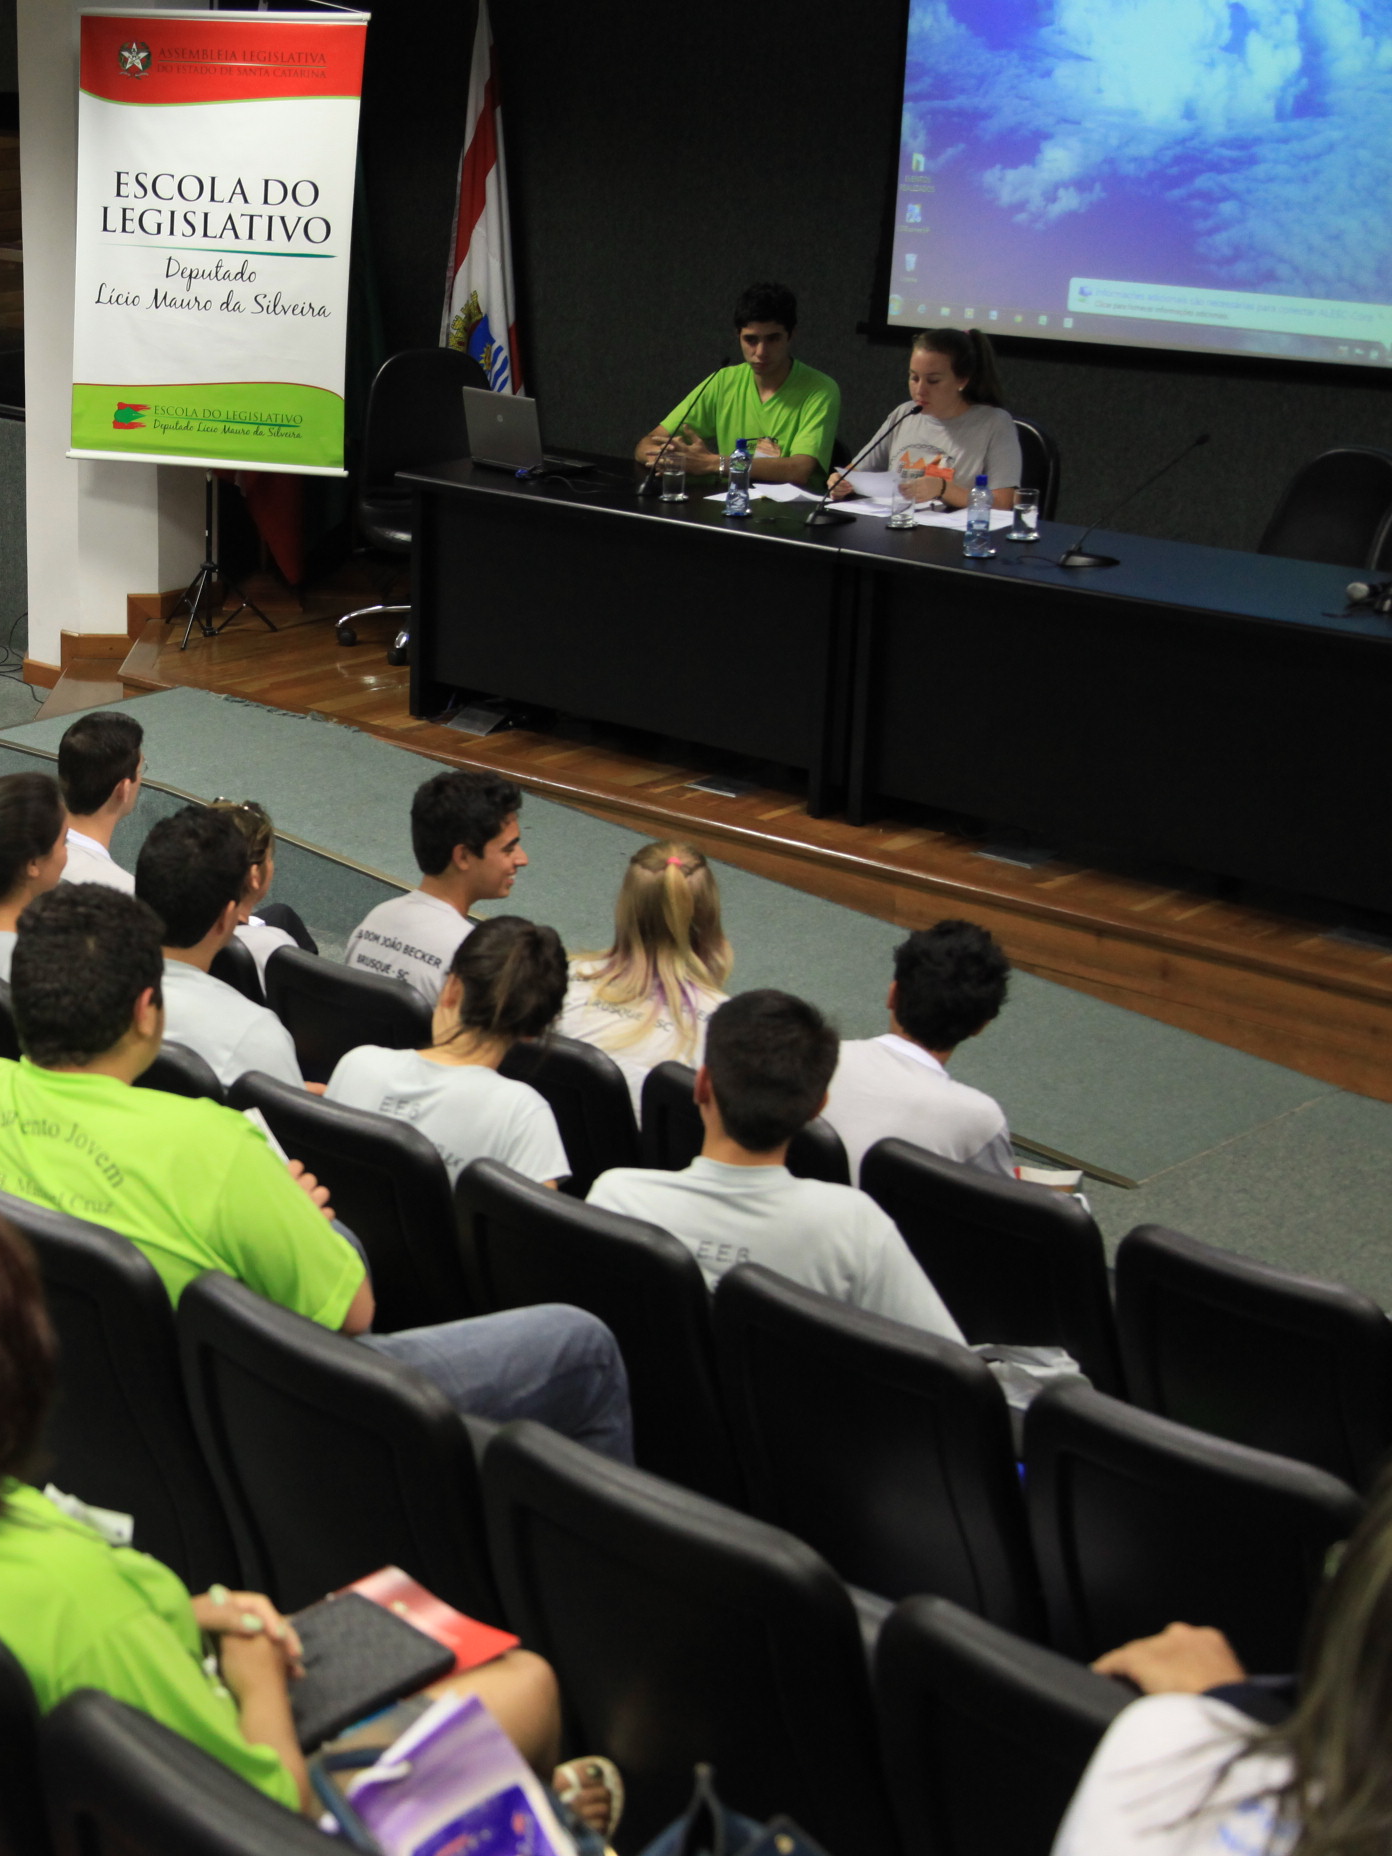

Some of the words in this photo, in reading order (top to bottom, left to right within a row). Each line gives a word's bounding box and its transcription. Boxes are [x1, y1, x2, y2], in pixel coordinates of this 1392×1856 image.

[158, 65, 172, 73] DO
[176, 66, 216, 75] ESTADO
[220, 67, 233, 76] DE
[237, 68, 269, 77] SANTA
[272, 69, 326, 79] CATARINA
[159, 47, 237, 62] ASSEMBLEIA
[242, 50, 326, 64] LEGISLATIVA
[114, 170, 251, 205] ESCOLA
[261, 178, 320, 207] DO
[100, 206, 332, 244] LEGISLATIVO
[165, 256, 257, 292] Deputado
[95, 283, 141, 307] Lício
[146, 288, 213, 312] Mauro
[219, 290, 246, 314] da
[251, 291, 332, 318] Silveira
[153, 419, 193, 435] Deputado
[222, 424, 250, 435] Mauro
[253, 427, 265, 436] da
[268, 427, 302, 439] Silveira
[154, 405, 198, 417] ESCOLA
[202, 408, 222, 419] DO
[226, 410, 303, 424] LEGISLATIVO
[357, 953, 392, 974] BRUSQUE
[363, 930, 381, 943] DOM
[380, 936, 403, 952] JOÃO
[403, 944, 443, 969] BECKER
[64, 1122, 124, 1189] Jovem
